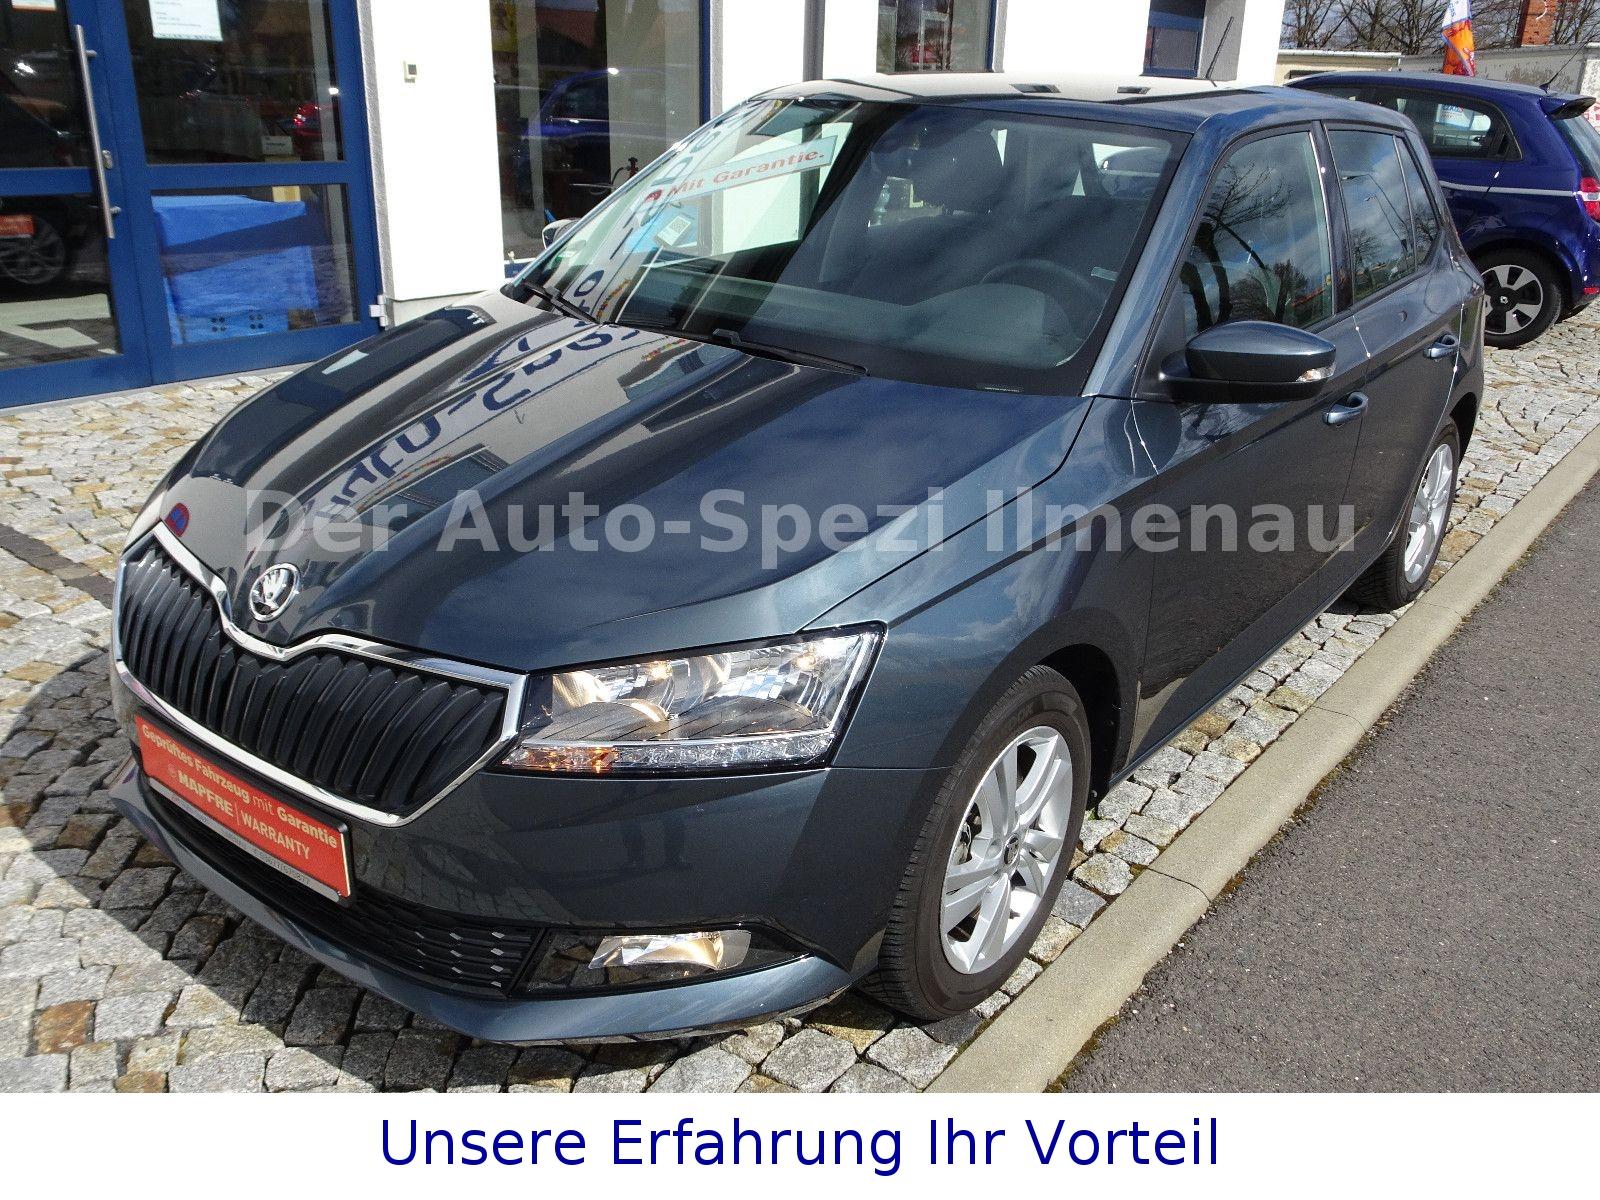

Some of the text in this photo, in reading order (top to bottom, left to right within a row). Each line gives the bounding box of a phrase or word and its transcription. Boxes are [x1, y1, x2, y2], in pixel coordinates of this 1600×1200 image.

[712, 149, 825, 184] Garantie.
[142, 723, 195, 768] Geprüftes
[193, 757, 250, 805] Fahrzeug
[252, 795, 275, 816] mit
[276, 806, 338, 849] Garantie
[177, 769, 234, 818] MAPFRE
[240, 809, 311, 860] WARRANTY
